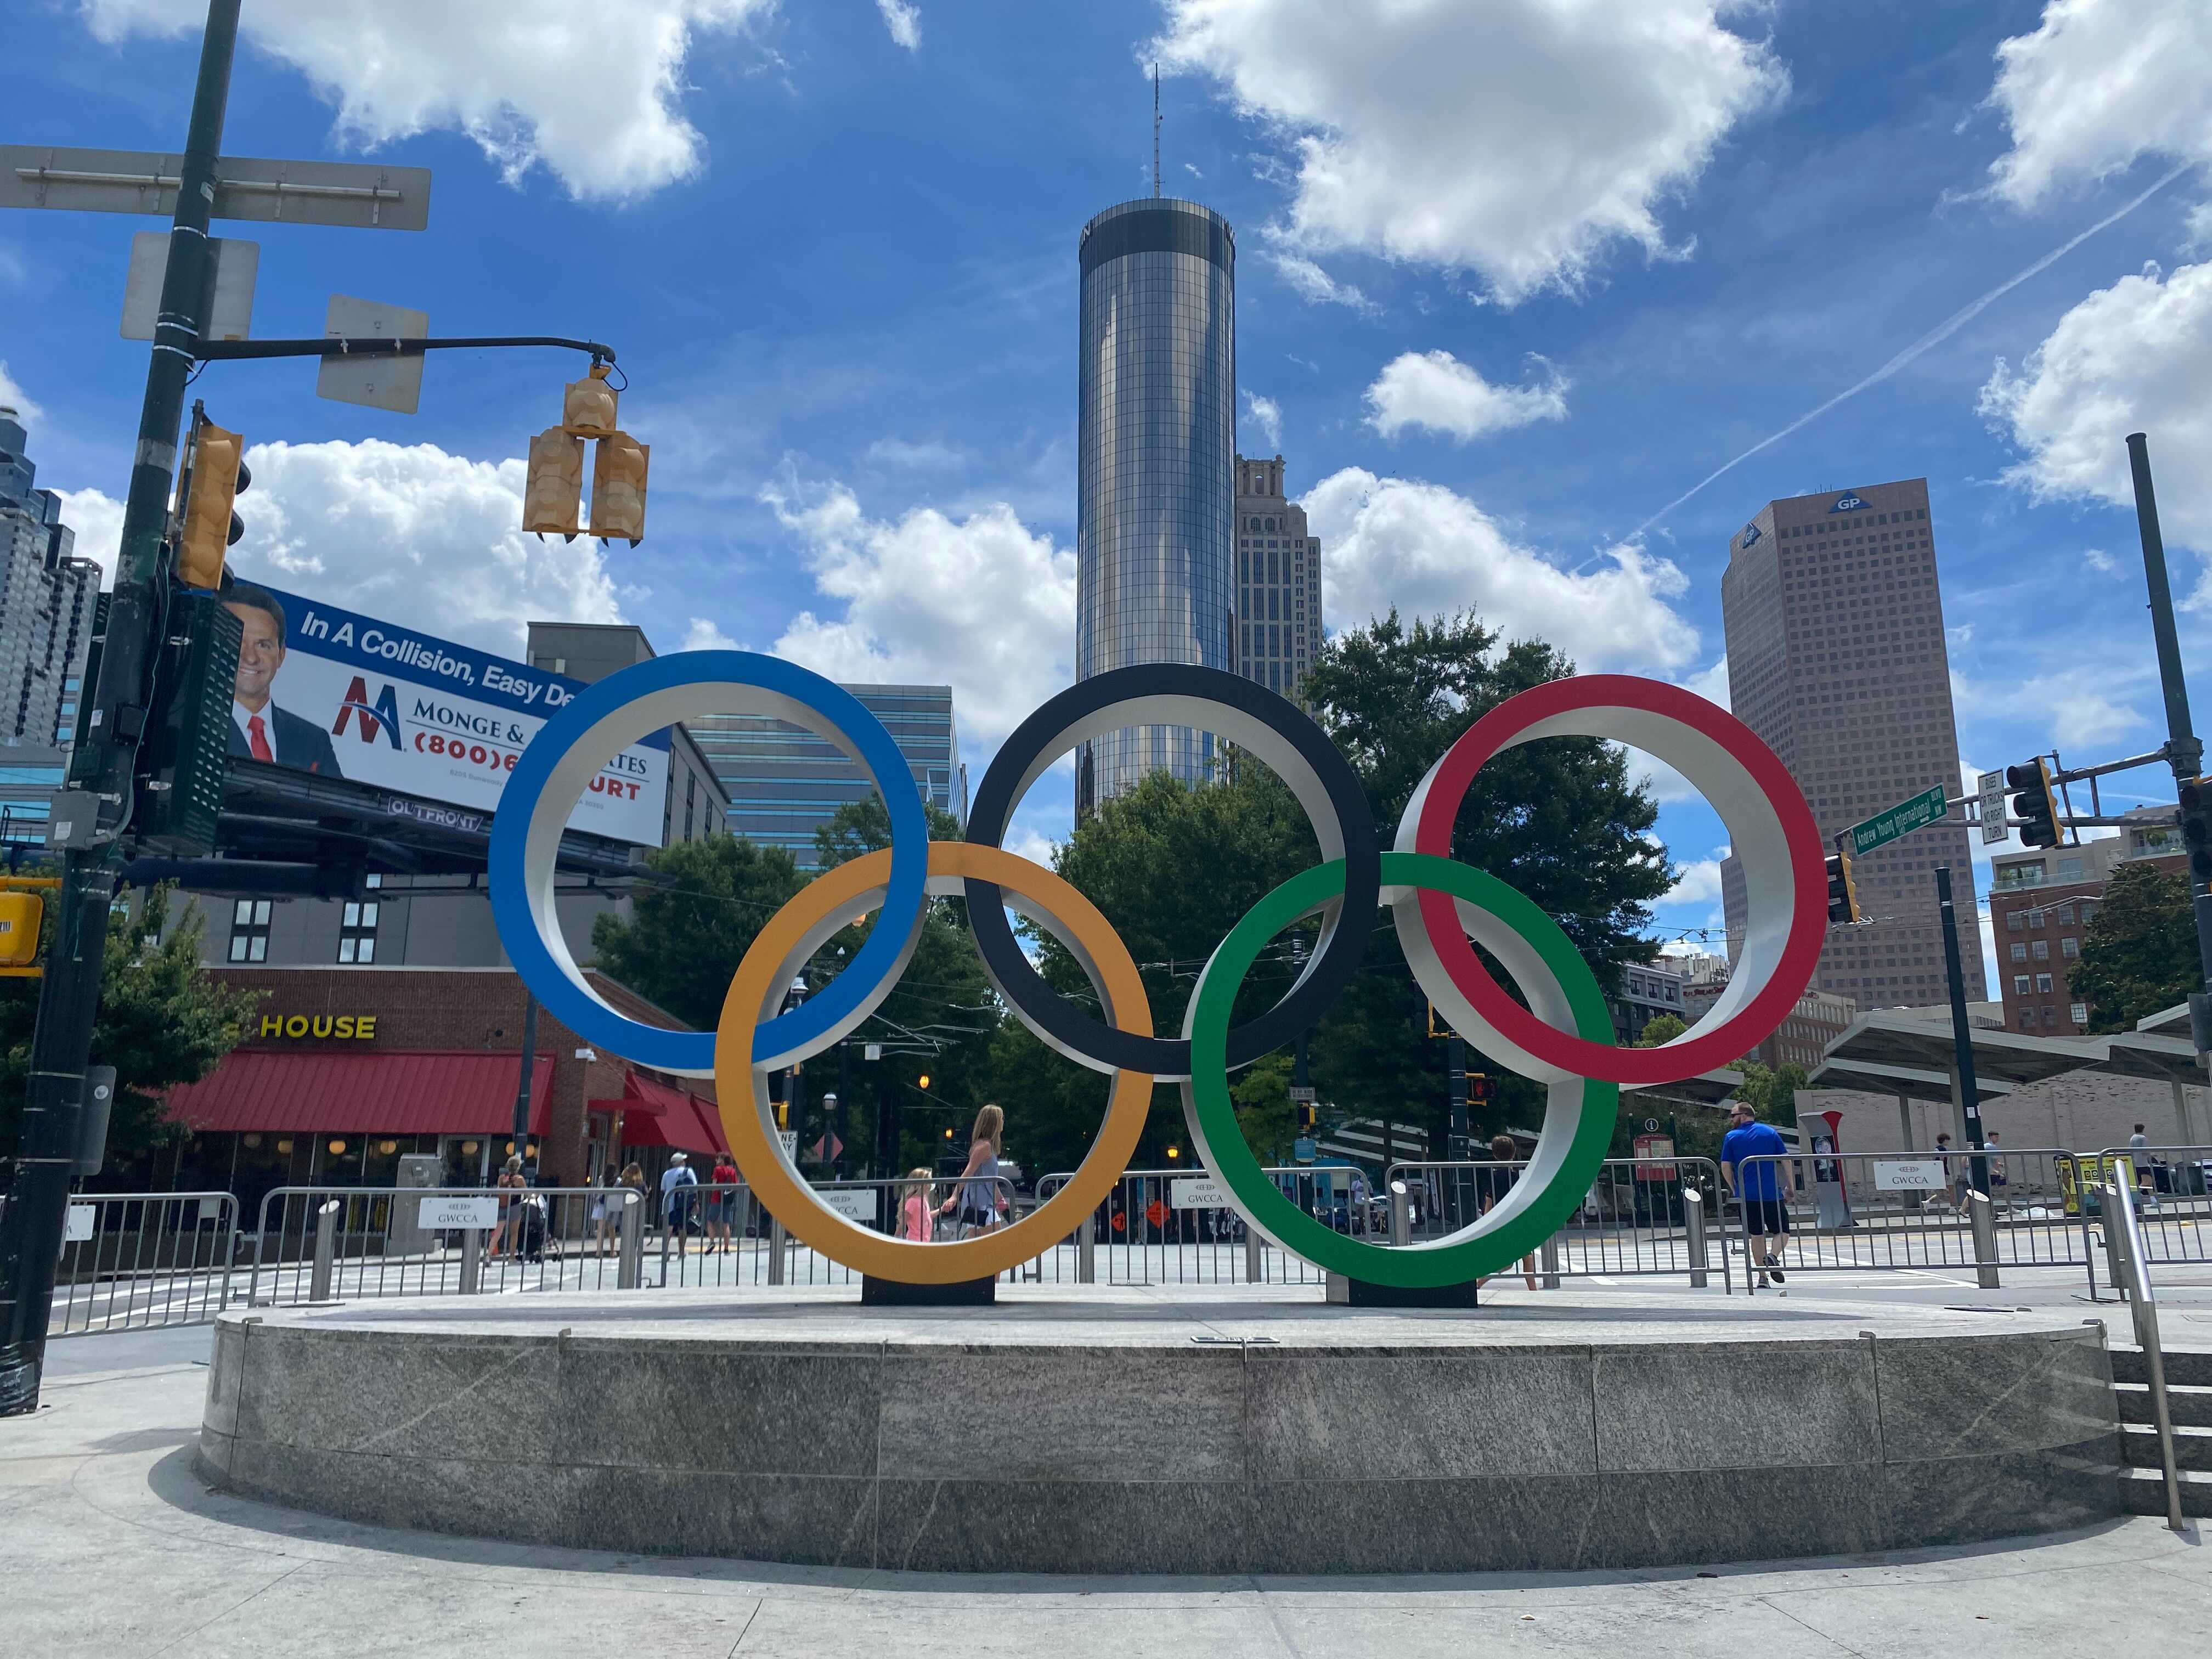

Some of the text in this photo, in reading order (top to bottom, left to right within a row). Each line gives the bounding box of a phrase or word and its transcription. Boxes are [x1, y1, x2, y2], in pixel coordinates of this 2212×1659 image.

[1838, 498, 1860, 510] GP
[1745, 528, 1754, 543] GP
[301, 610, 329, 640] In
[331, 622, 354, 648] A
[360, 630, 475, 686] Collision,
[481, 664, 543, 702] Easy
[413, 697, 501, 738] MONGE
[506, 723, 526, 745] &
[1931, 788, 1942, 802] BLVD
[1980, 790, 2003, 808] OR TRUCKS
[392, 800, 477, 830] OUTFRONT
[1984, 807, 2002, 822] NO RIGHT
[1857, 798, 1931, 847] Andrew Young International
[1988, 825, 2002, 839] TURN
[260, 1014, 377, 1039] HOUSE
[1892, 1176, 1928, 1184] GWCCA
[1188, 1194, 1223, 1203] GWCCA
[438, 1213, 478, 1223] GWCCA
[837, 1206, 858, 1215] CCA
